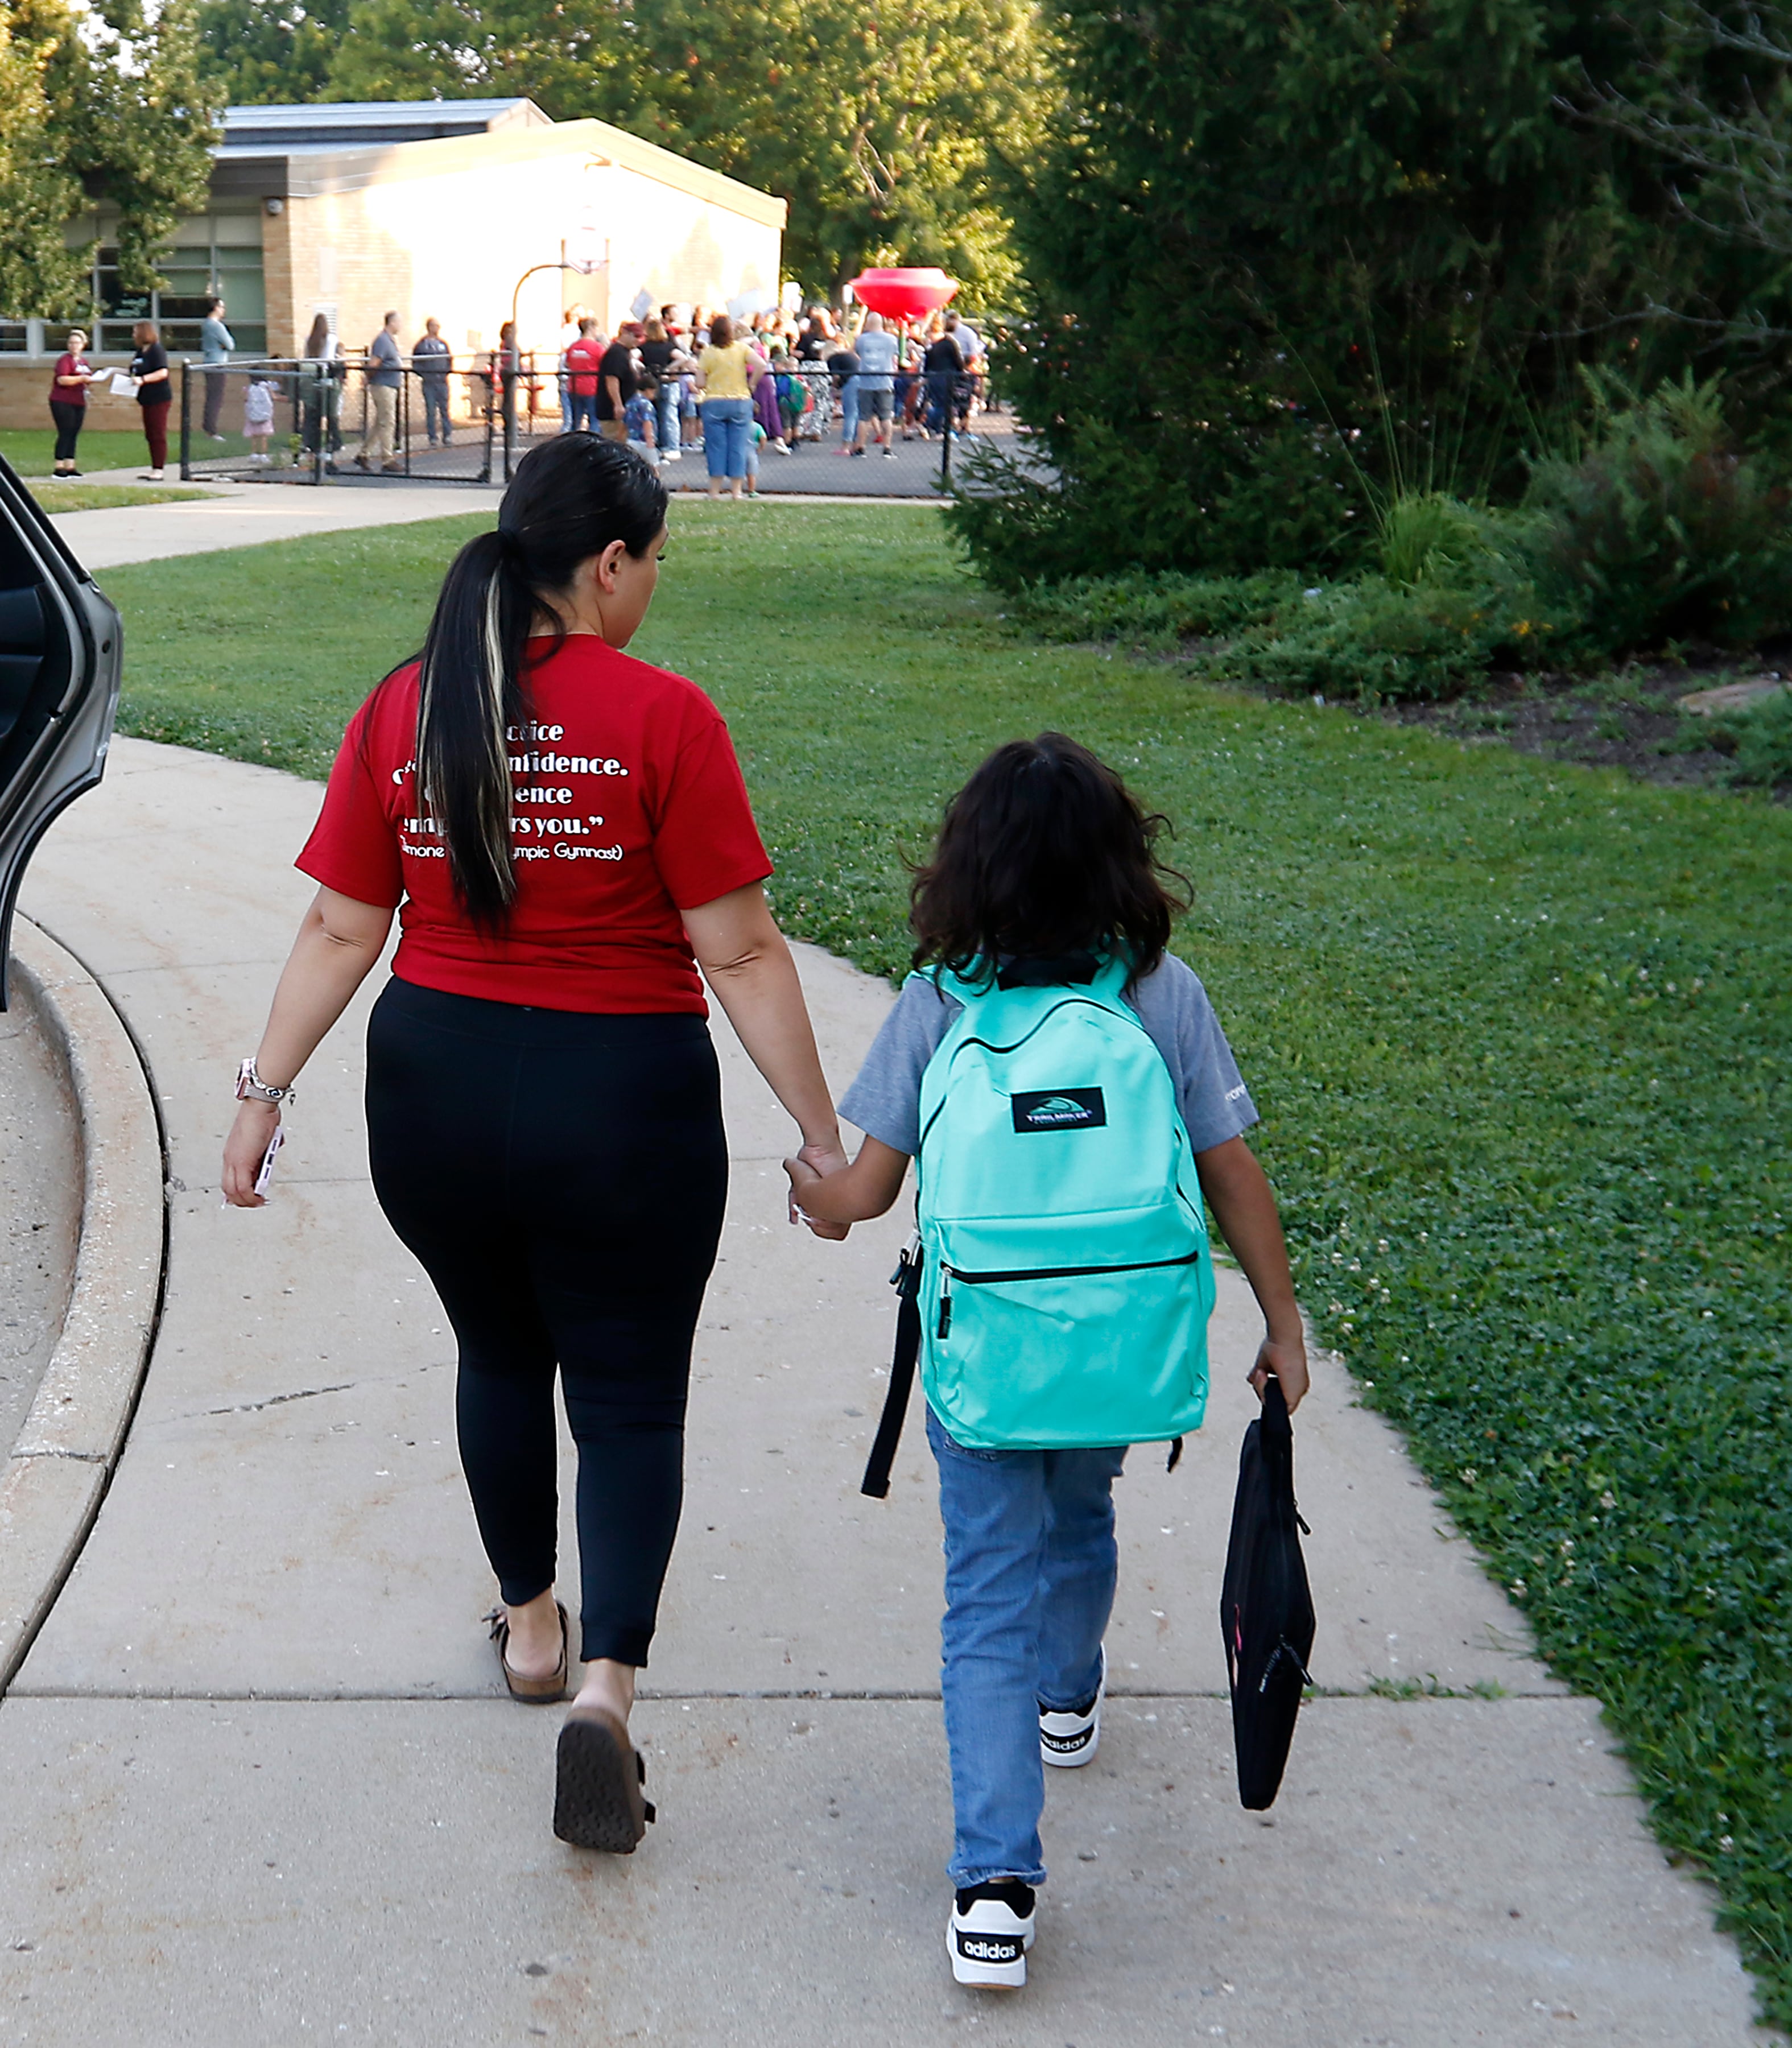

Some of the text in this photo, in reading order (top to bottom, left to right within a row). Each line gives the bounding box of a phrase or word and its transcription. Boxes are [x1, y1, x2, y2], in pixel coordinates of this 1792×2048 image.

[509, 751, 629, 776] nfidence.
[554, 842, 623, 861] Gymnast)
[964, 1940, 1016, 1959] adidas
